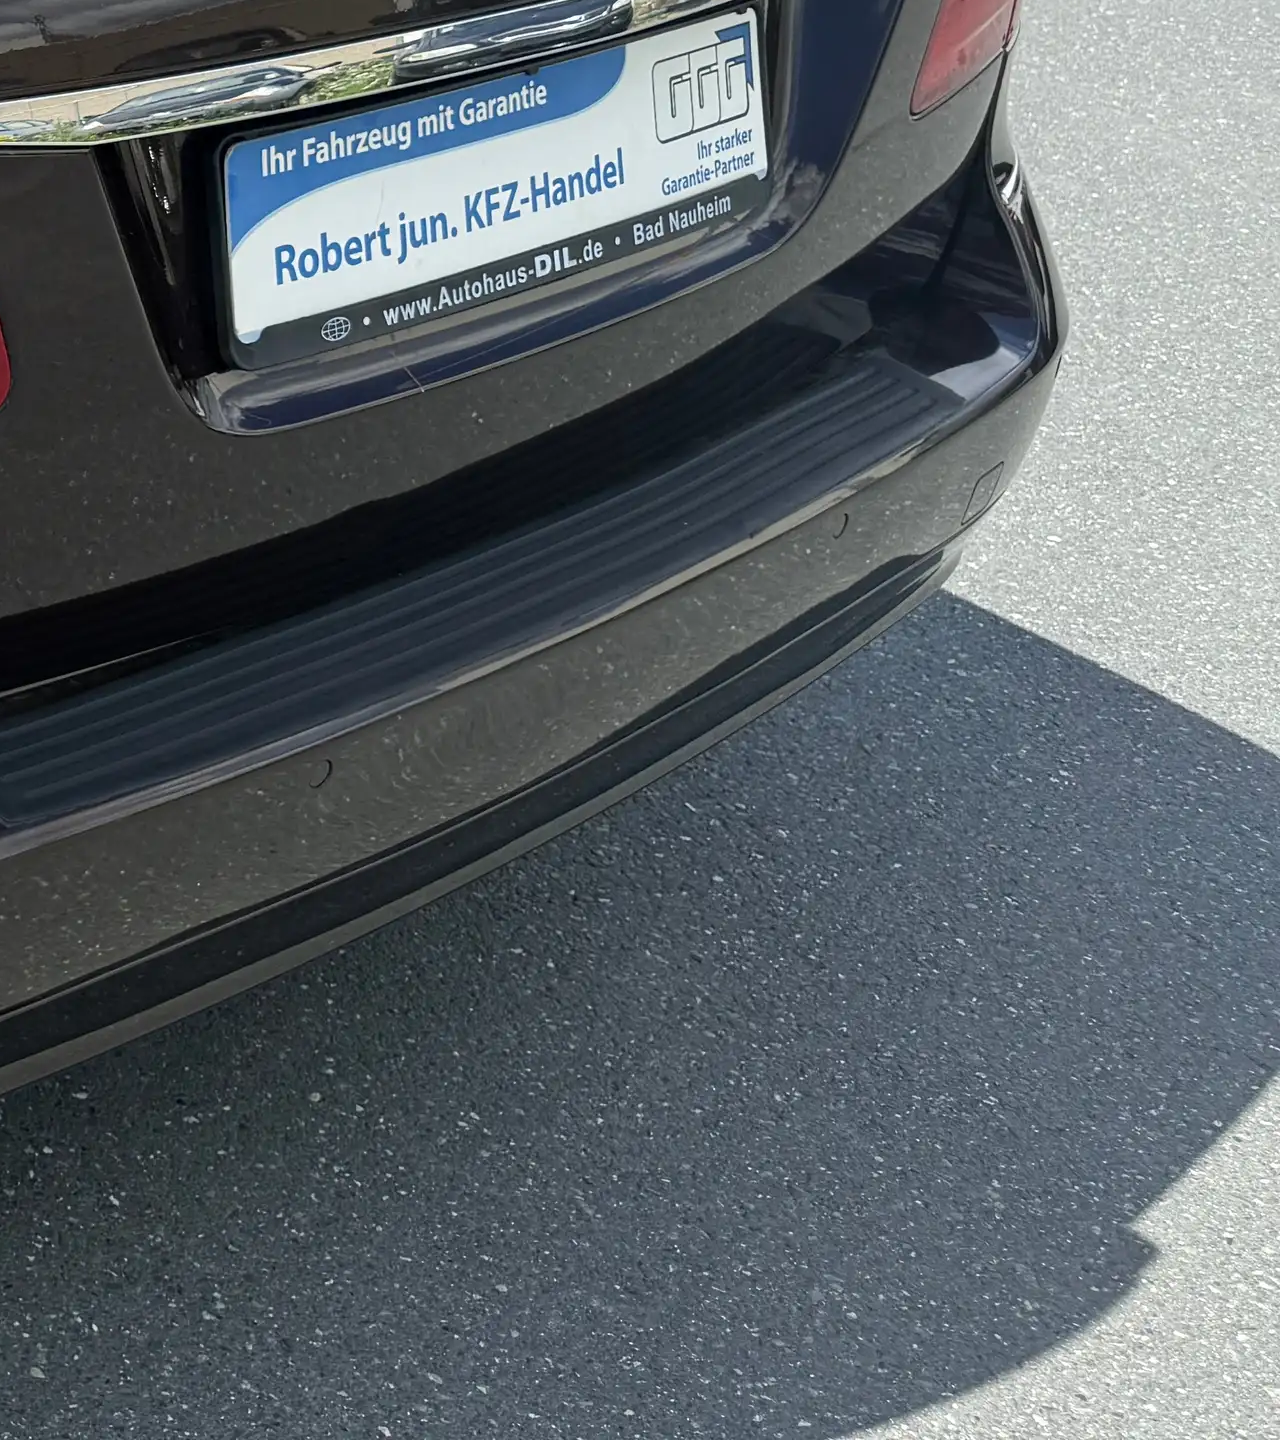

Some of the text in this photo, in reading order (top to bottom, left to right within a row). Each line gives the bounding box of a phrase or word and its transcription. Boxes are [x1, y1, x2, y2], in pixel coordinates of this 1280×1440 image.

[260, 80, 547, 178] Ihr Fahrzeug mit Garantie
[661, 152, 755, 196] Garantie-Partner
[696, 127, 753, 160] Ihr starker
[274, 146, 625, 286] Robert jun. KFZ-Handel
[383, 194, 732, 327] www.Autohaus-DIL.de Bad Nauheim
